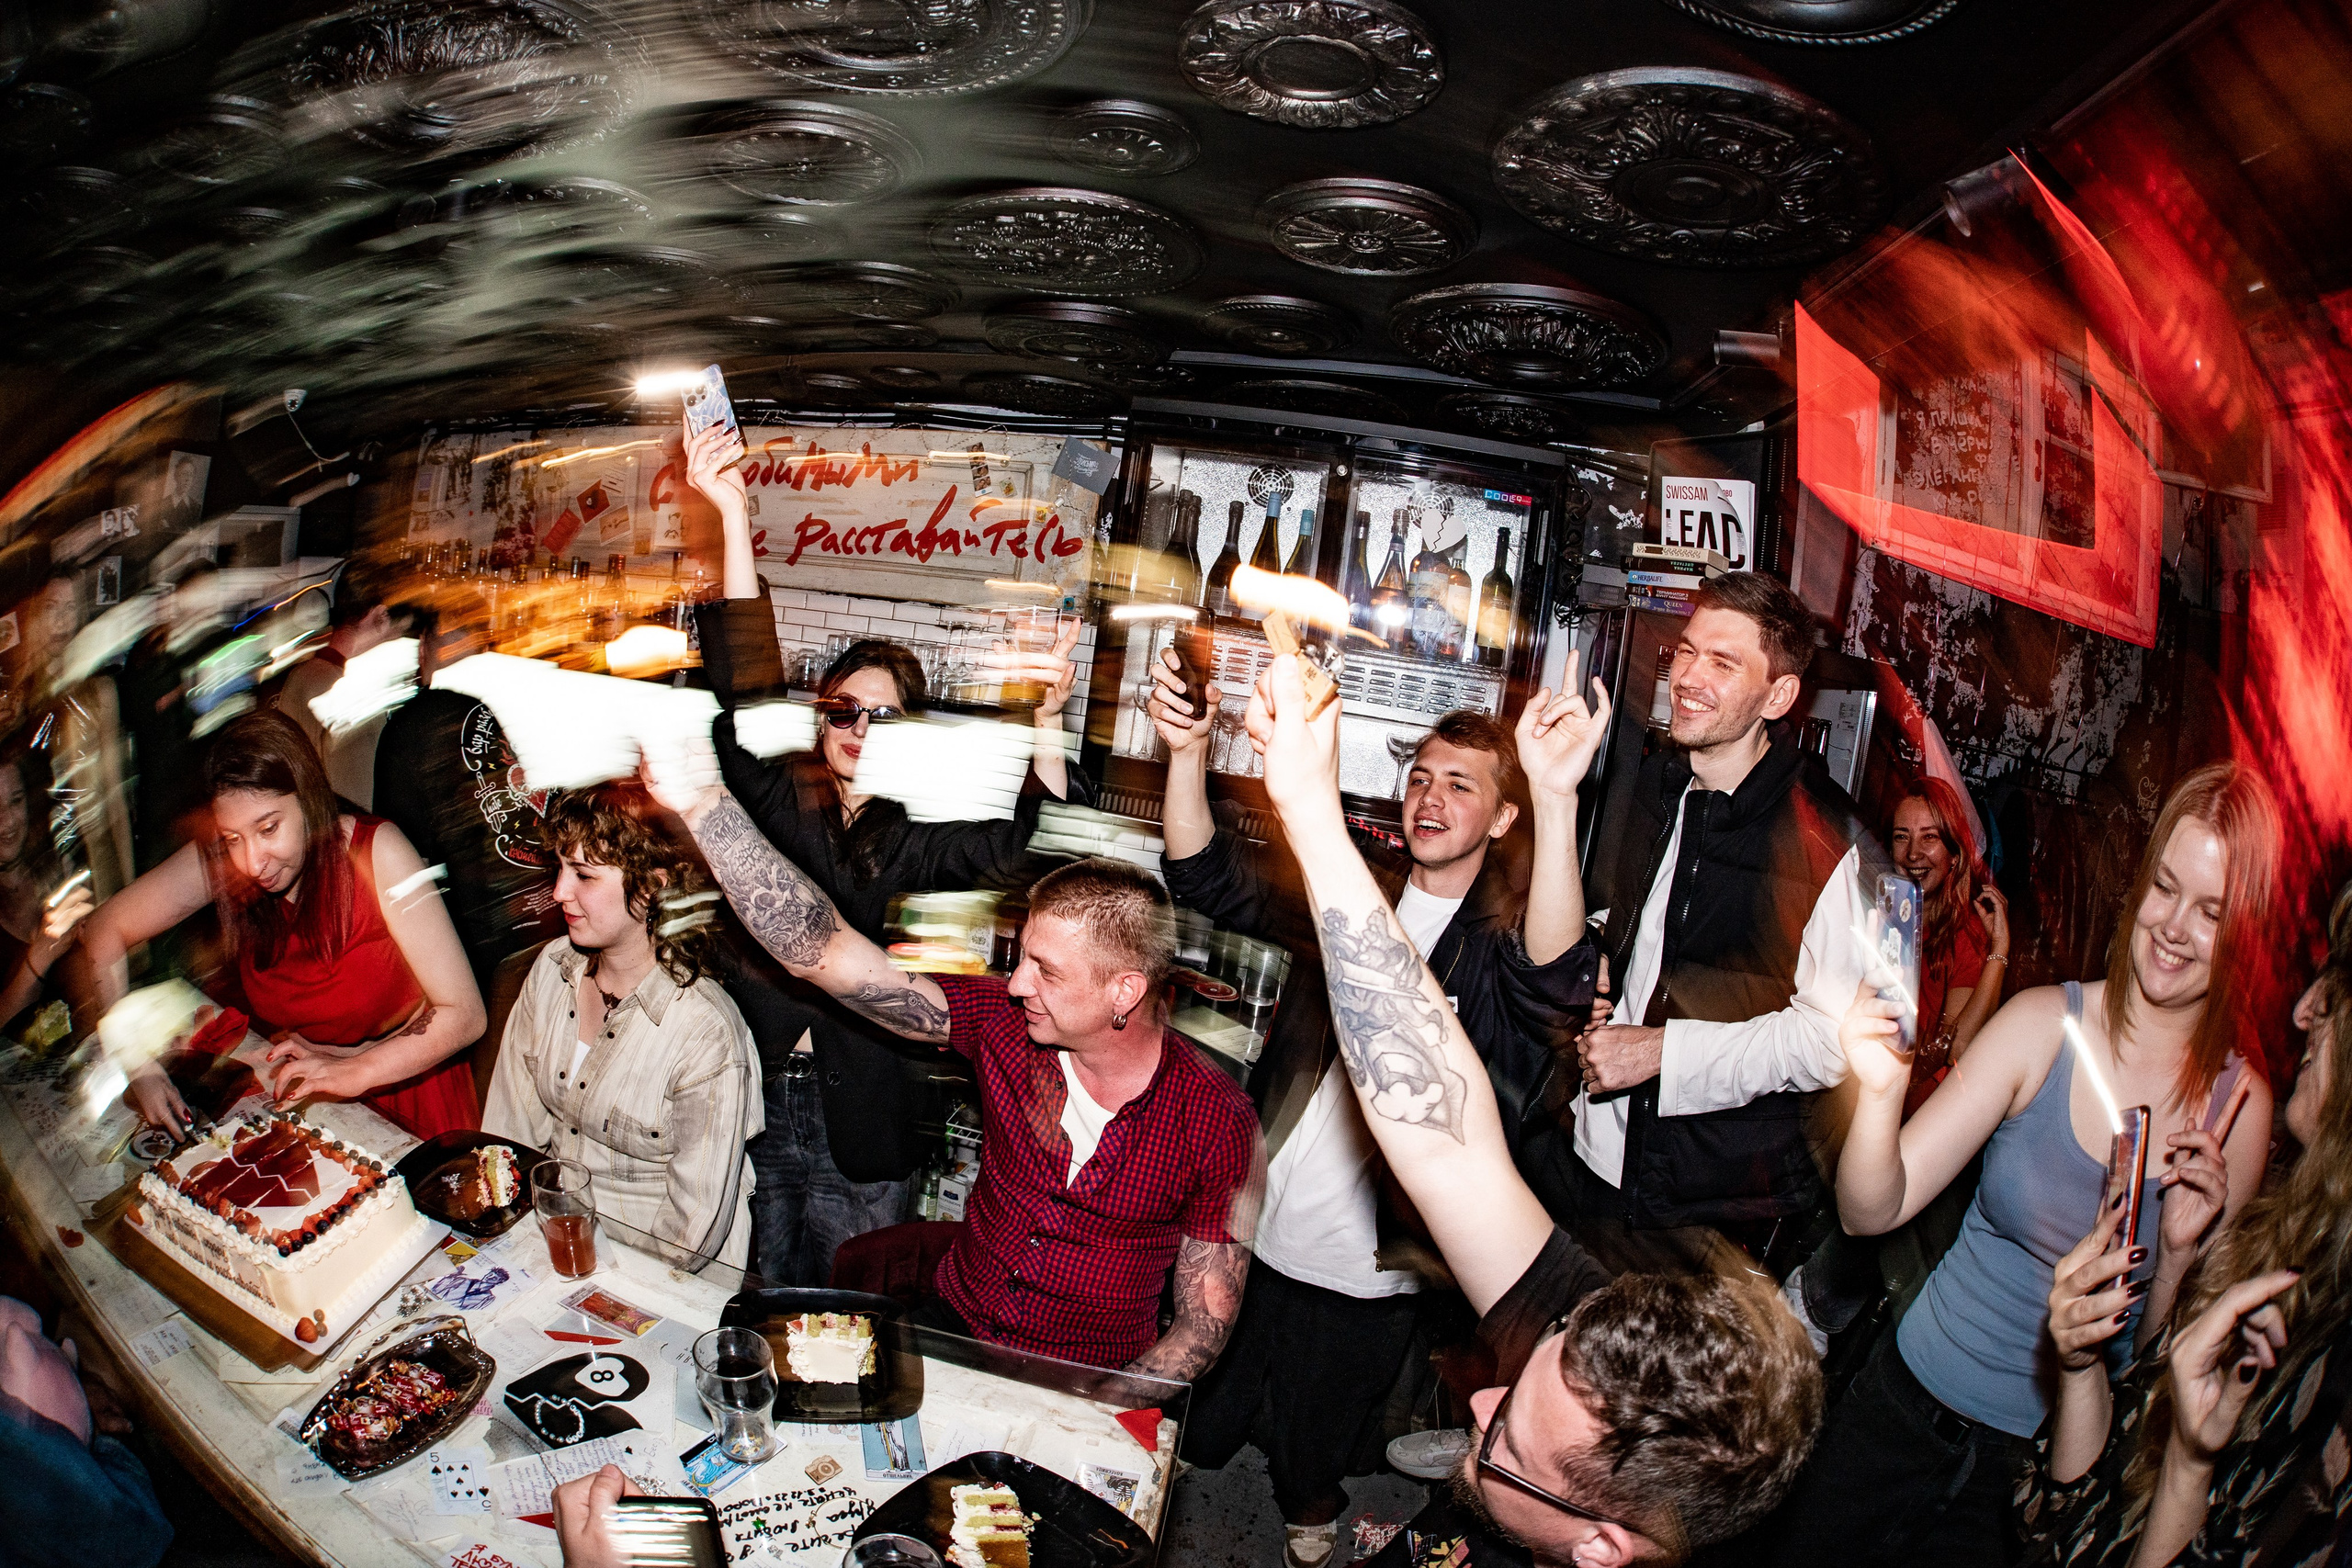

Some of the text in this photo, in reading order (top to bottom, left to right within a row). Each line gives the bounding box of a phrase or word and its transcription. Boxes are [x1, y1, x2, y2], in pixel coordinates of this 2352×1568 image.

[742, 435, 919, 492] бимыми
[1666, 485, 1709, 502] SWISSAM
[1637, 574, 1663, 583] HERBALIFE
[430, 1452, 440, 1462] 5
